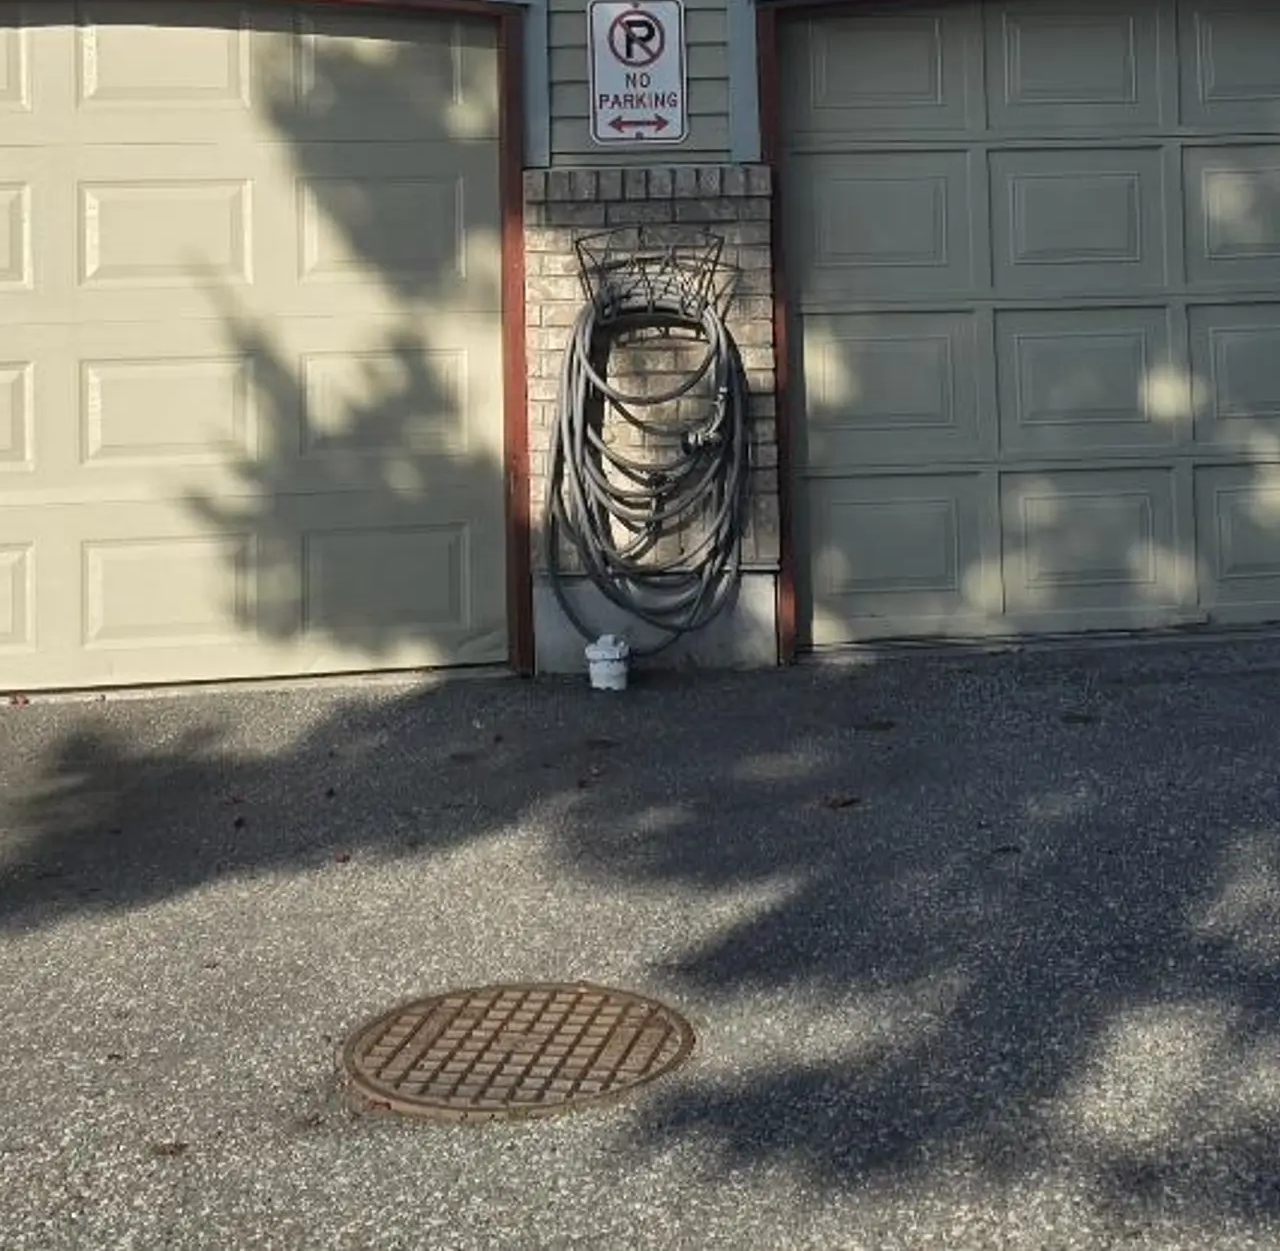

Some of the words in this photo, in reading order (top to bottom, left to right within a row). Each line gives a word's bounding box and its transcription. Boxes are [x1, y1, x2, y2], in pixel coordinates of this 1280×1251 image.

[625, 19, 655, 59] P
[625, 73, 651, 88] NO
[599, 93, 678, 110] PARKING
